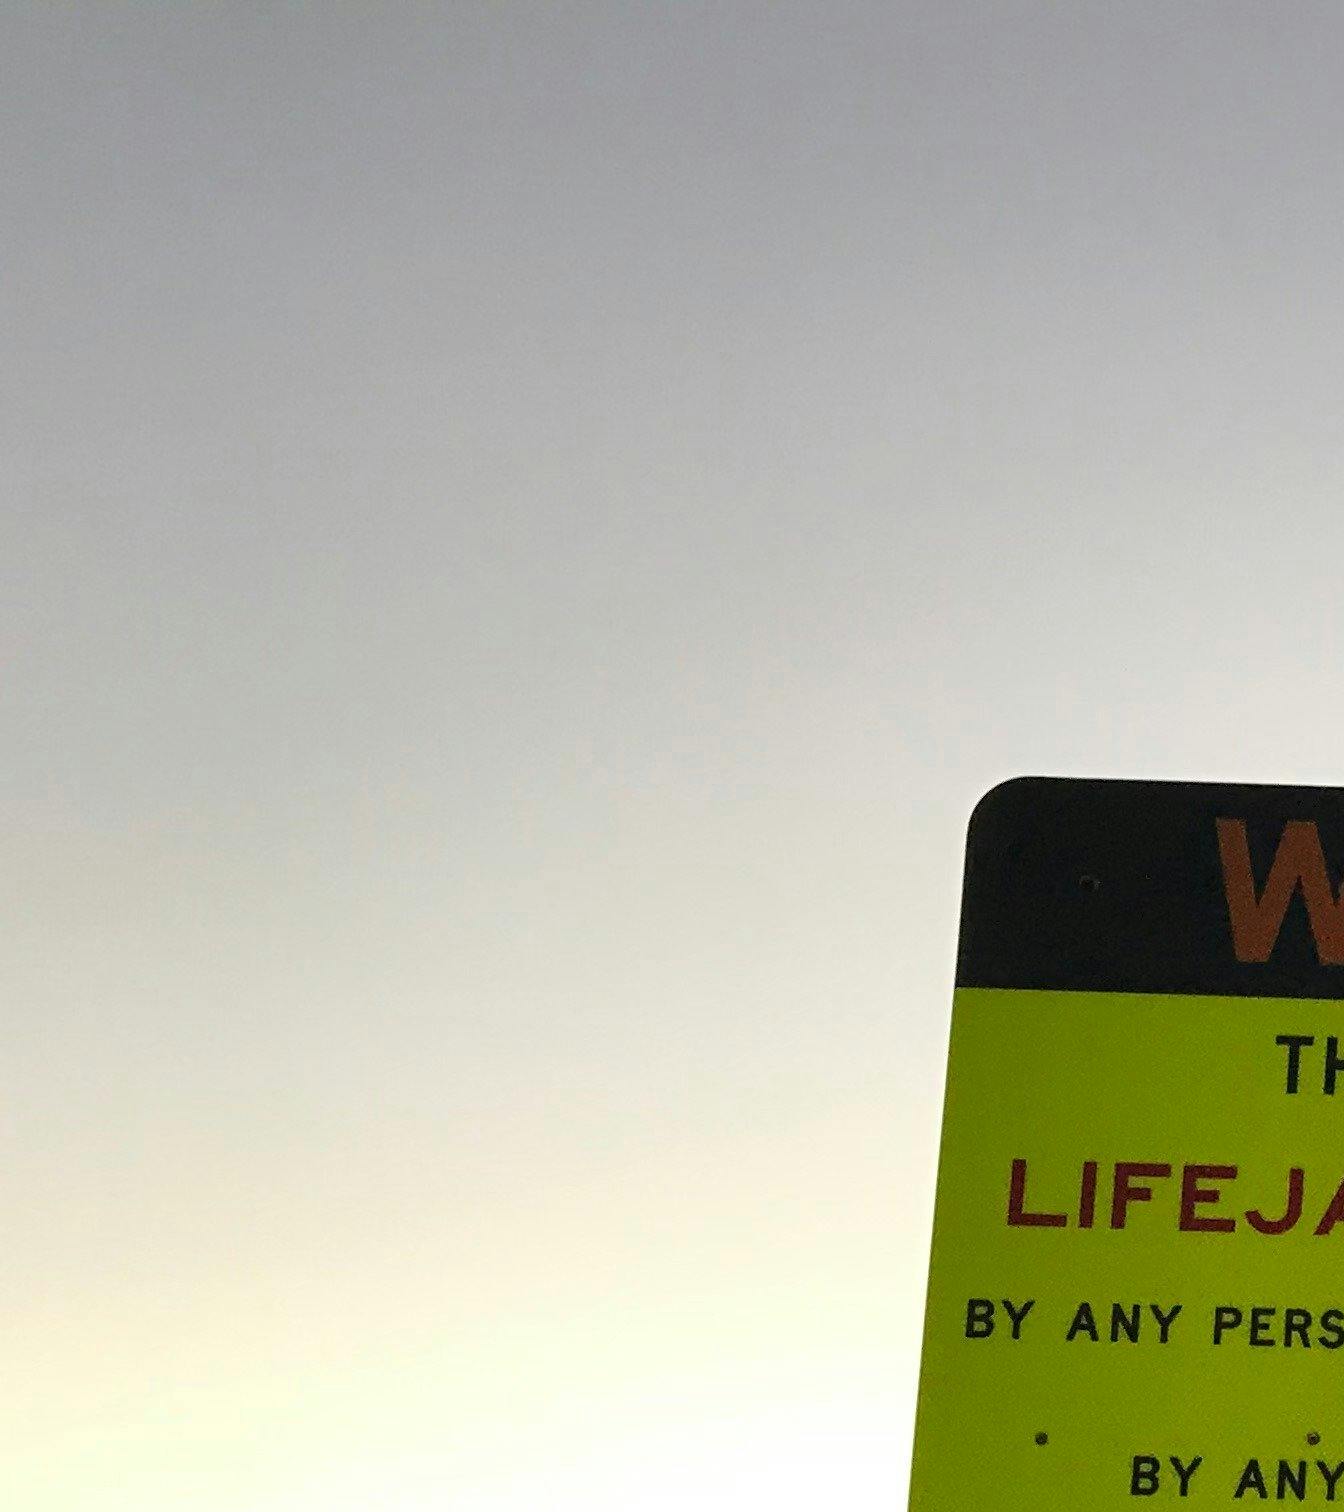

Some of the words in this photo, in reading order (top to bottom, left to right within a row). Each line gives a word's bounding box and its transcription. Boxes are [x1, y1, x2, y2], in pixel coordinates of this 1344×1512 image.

[965, 1299, 1035, 1339] BY
[1066, 1302, 1183, 1343] ANY
[1129, 1457, 1201, 1497] BY
